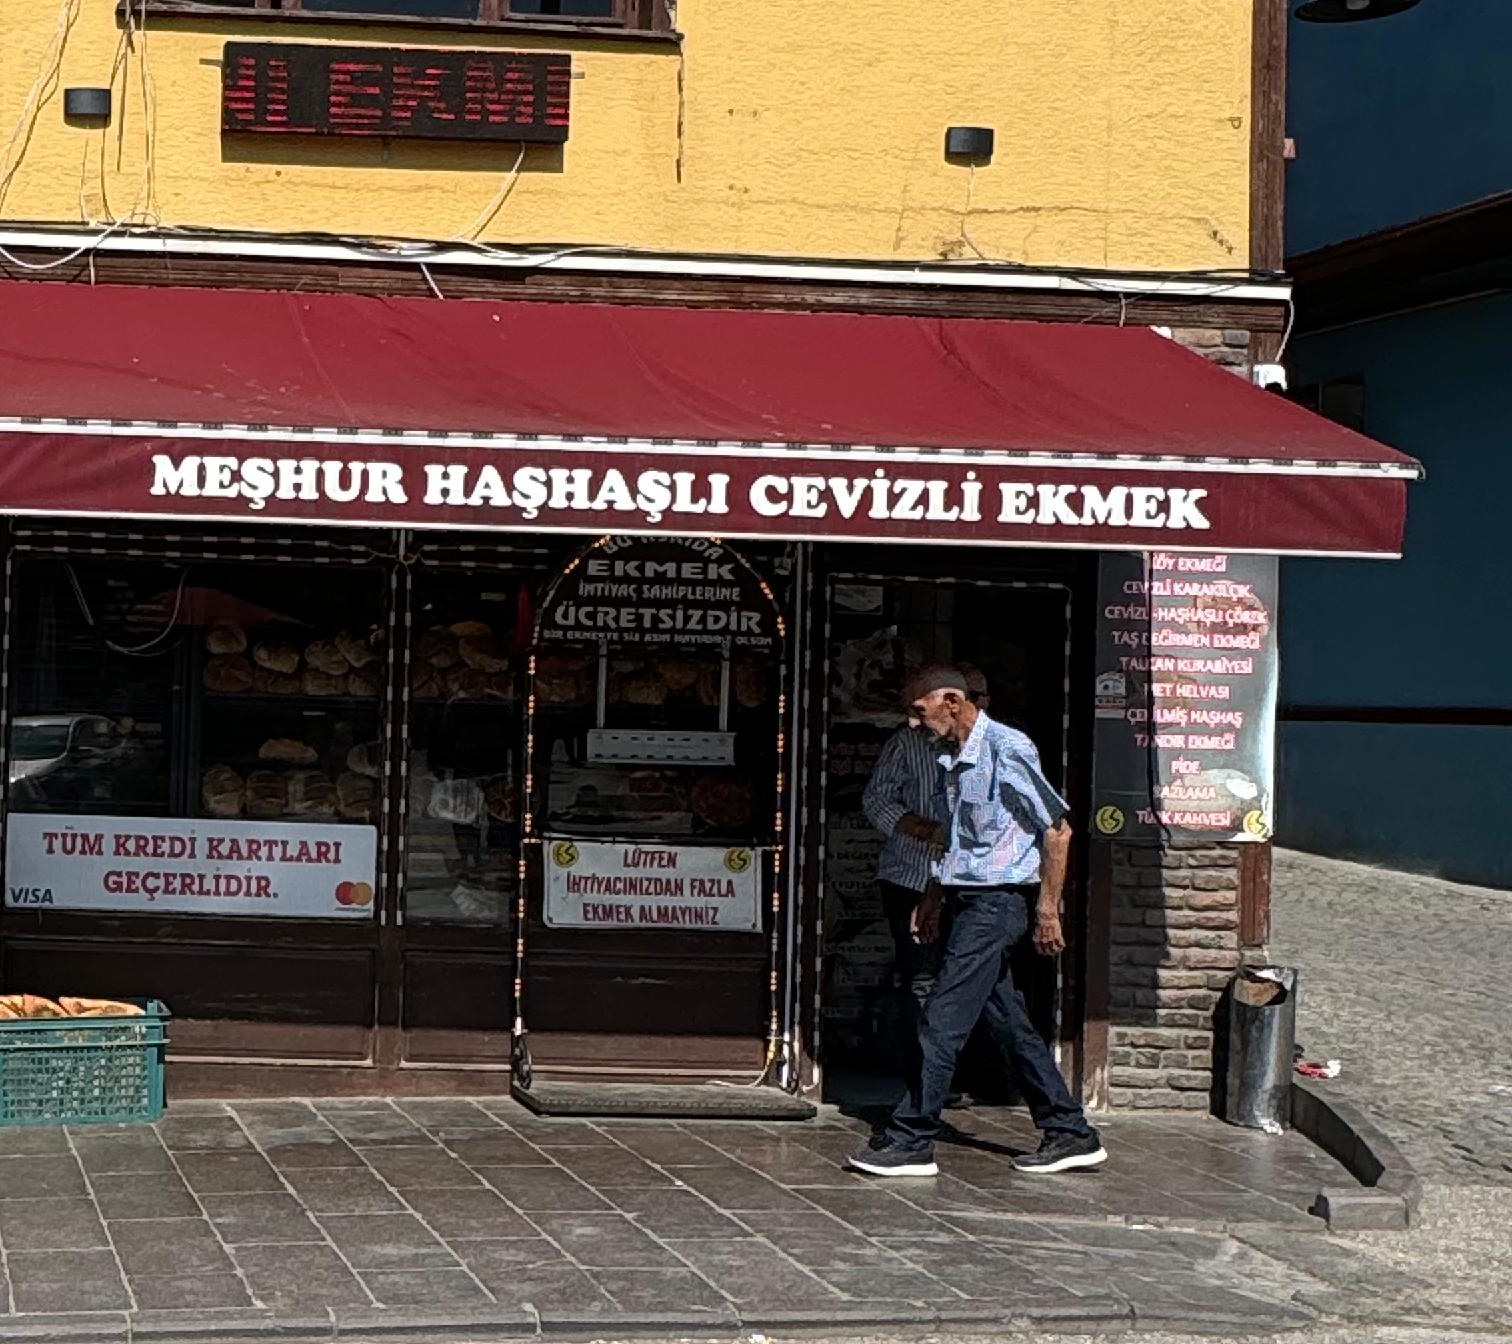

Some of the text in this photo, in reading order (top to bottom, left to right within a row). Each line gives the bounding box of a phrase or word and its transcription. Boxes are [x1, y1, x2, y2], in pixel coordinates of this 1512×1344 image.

[149, 454, 1211, 530] MEŞHUR HAŞHAŞLI CEVİZLİ EKMEK
[587, 559, 737, 580] EKMEK
[578, 578, 741, 601] İHTİYAÇ SAHİPLERİNE
[554, 600, 762, 634] ÜCRETSİZDİR
[1111, 631, 1139, 648] TAŞ
[43, 826, 342, 865] TÜM KREDİ KARTLARI
[623, 847, 678, 869] LÜTFEN
[103, 867, 279, 901] GEÇERLİDİR.
[690, 878, 735, 898] FAZLA
[10, 887, 54, 905] VISA
[583, 902, 634, 923] EKMEK
